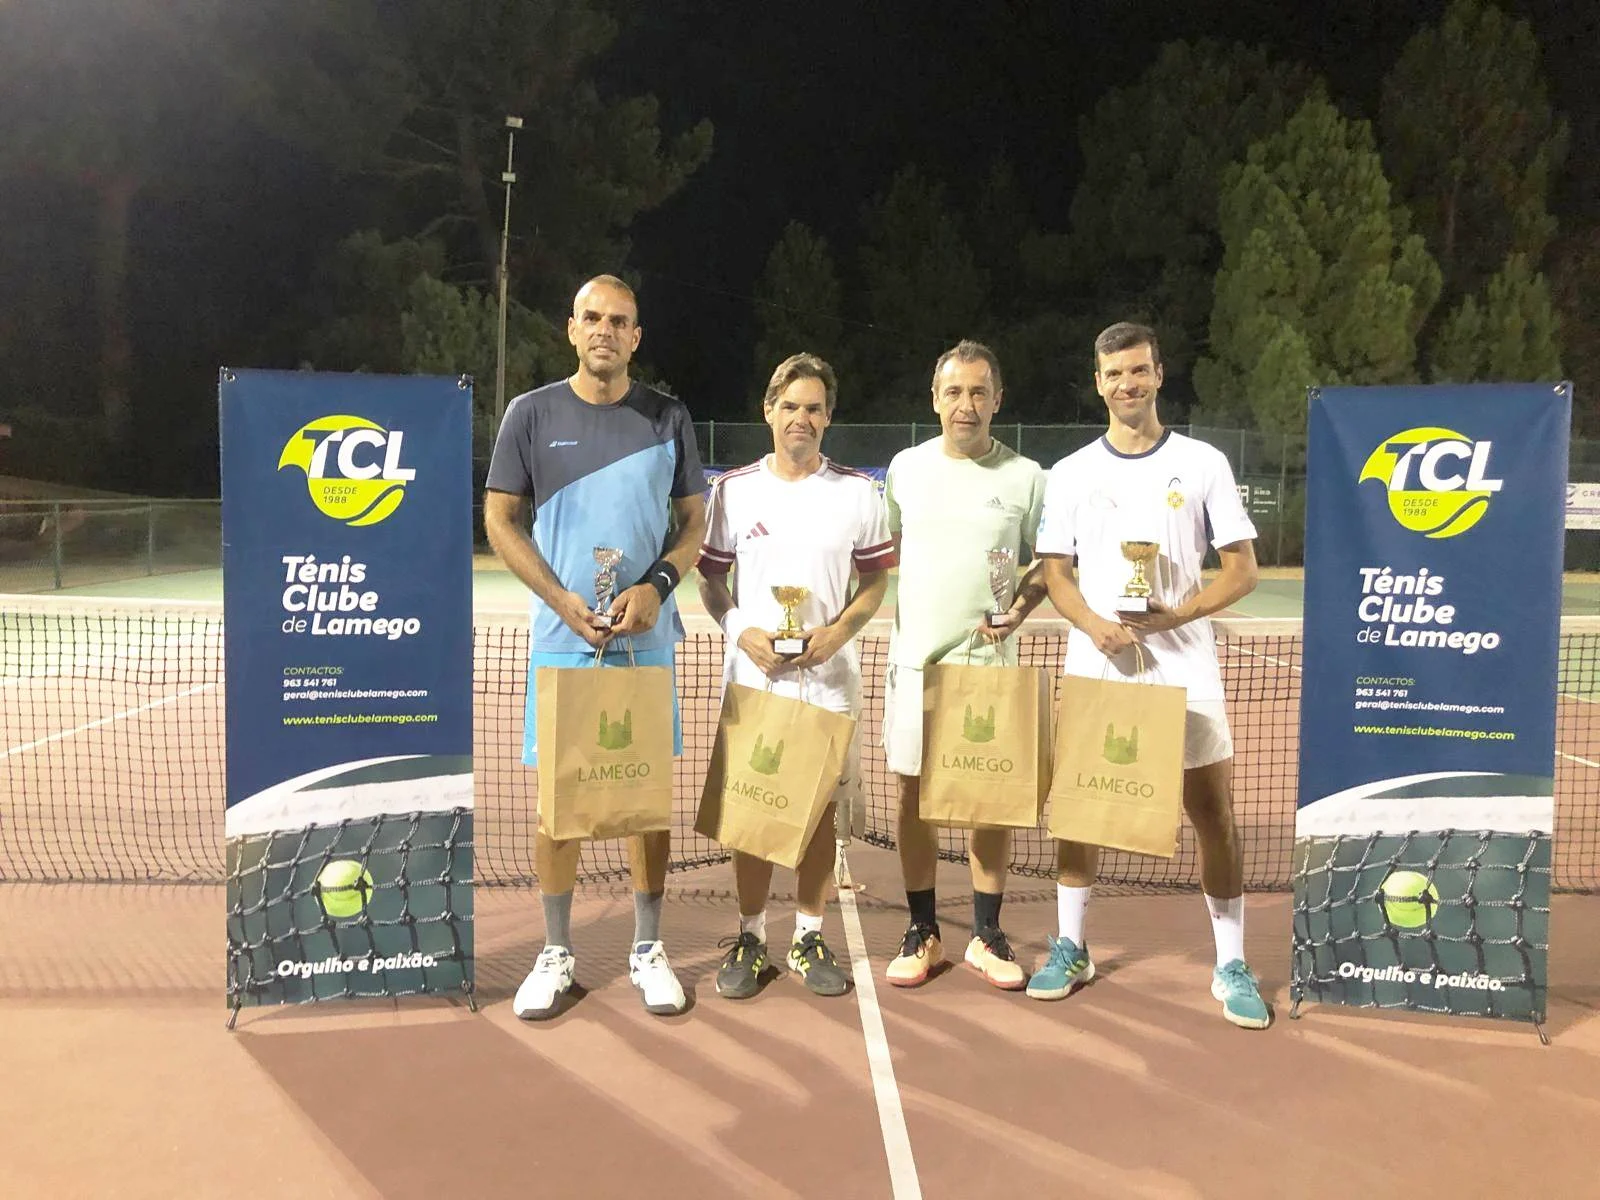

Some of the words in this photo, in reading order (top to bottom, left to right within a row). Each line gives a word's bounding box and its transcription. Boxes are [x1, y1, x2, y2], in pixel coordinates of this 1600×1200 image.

[303, 429, 416, 481] TCL
[1384, 440, 1504, 492] TCL
[323, 486, 358, 495] DESDE
[323, 495, 348, 504] 1988
[1403, 499, 1438, 507] DESDE
[1403, 508, 1427, 517] 1988
[282, 554, 367, 584] Ténis
[1358, 567, 1444, 596] Ténis
[282, 585, 379, 612] Clube
[1358, 597, 1455, 624] Clube
[282, 616, 308, 634] de
[312, 613, 420, 640] Lamego
[1357, 626, 1381, 644] de
[1385, 625, 1500, 655] Lamego
[283, 667, 344, 676] CONTACTOS:
[1356, 677, 1416, 686] CONTACTOS:
[283, 679, 301, 687] 963
[303, 679, 319, 687] 541
[321, 678, 337, 687] 761
[283, 689, 428, 701] geral@tenisclubelamego.com
[1355, 688, 1373, 697] 963
[1375, 689, 1390, 697] 541
[1393, 689, 1408, 698] 761
[1355, 700, 1505, 714] geral@tenisclubelamego.com
[283, 713, 438, 725] www.tenisclubelamego.com
[1354, 725, 1515, 740] www.tenisclubelamego.com
[578, 762, 650, 782] LAMEGO
[942, 754, 1013, 774] LAMEGO
[724, 776, 788, 809] LAMEGO
[1077, 773, 1154, 799] LAMEGO
[277, 956, 354, 979] Orgulho
[358, 961, 369, 972] e
[372, 952, 438, 975] paixão.
[1338, 962, 1415, 983] Orgulho
[1419, 974, 1431, 985] e
[1434, 973, 1506, 992] paixão.
